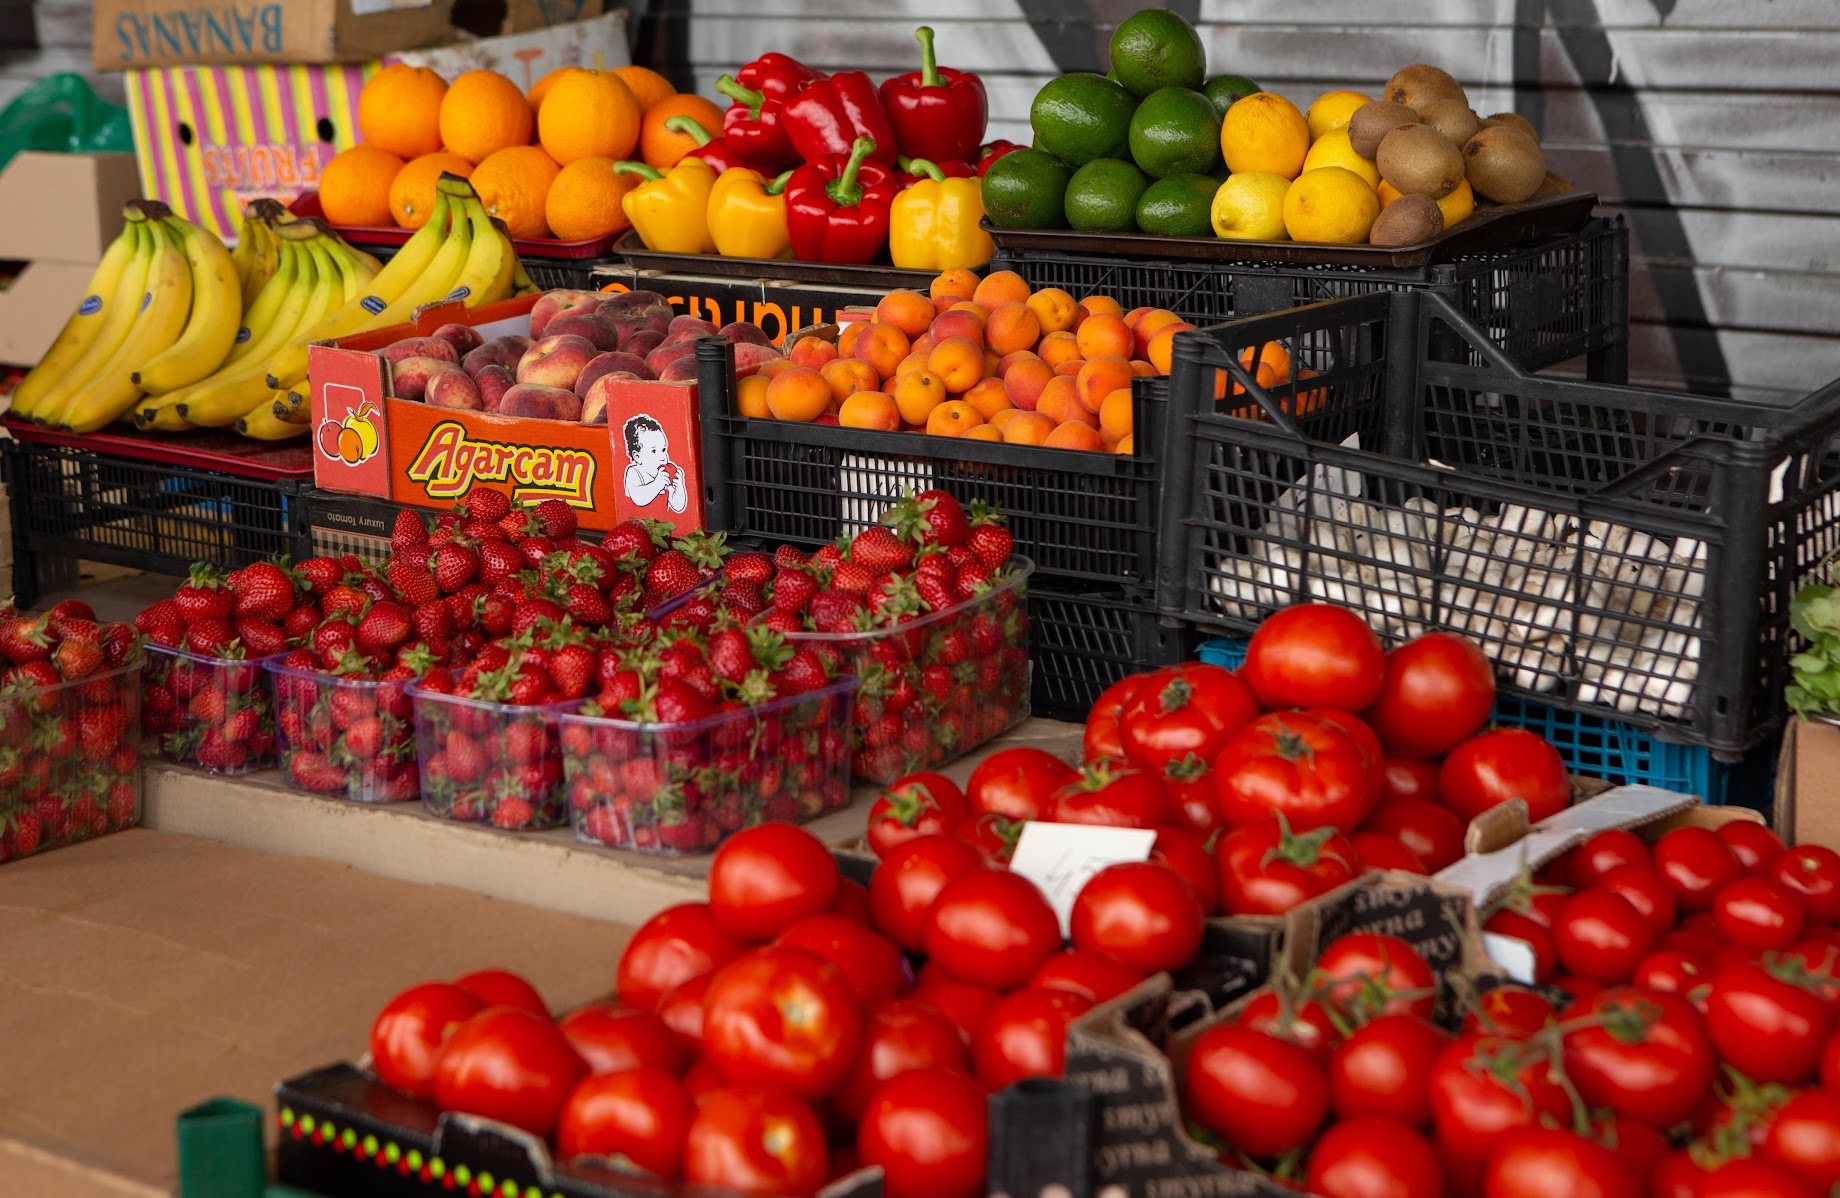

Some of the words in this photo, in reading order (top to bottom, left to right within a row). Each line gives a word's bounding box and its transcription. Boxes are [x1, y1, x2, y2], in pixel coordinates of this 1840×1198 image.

[116, 5, 284, 61] BANANAS
[202, 145, 320, 189] FRUITS
[408, 422, 595, 508] Agarcam
[326, 512, 356, 526] Tomato
[358, 515, 385, 530] Luxury
